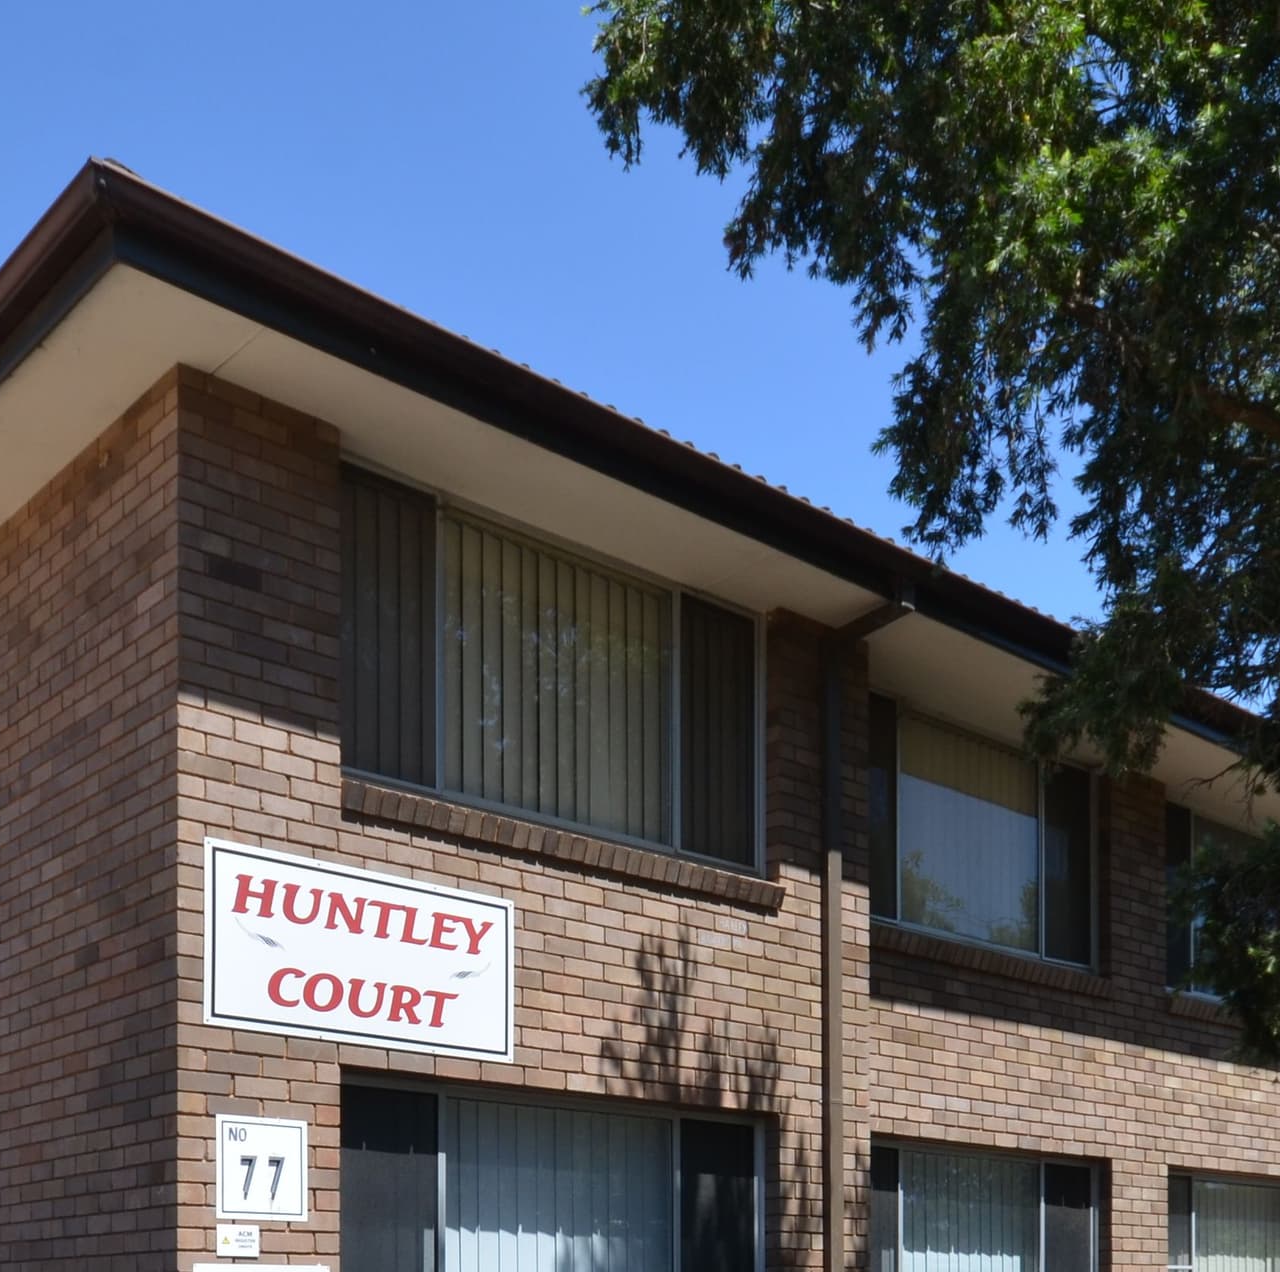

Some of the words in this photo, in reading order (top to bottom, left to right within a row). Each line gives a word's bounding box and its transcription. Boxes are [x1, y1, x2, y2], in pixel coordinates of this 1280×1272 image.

[231, 873, 493, 955] HUNTLEY
[268, 967, 458, 1027] COURT
[228, 1127, 247, 1142] NO
[240, 1155, 285, 1200] 77
